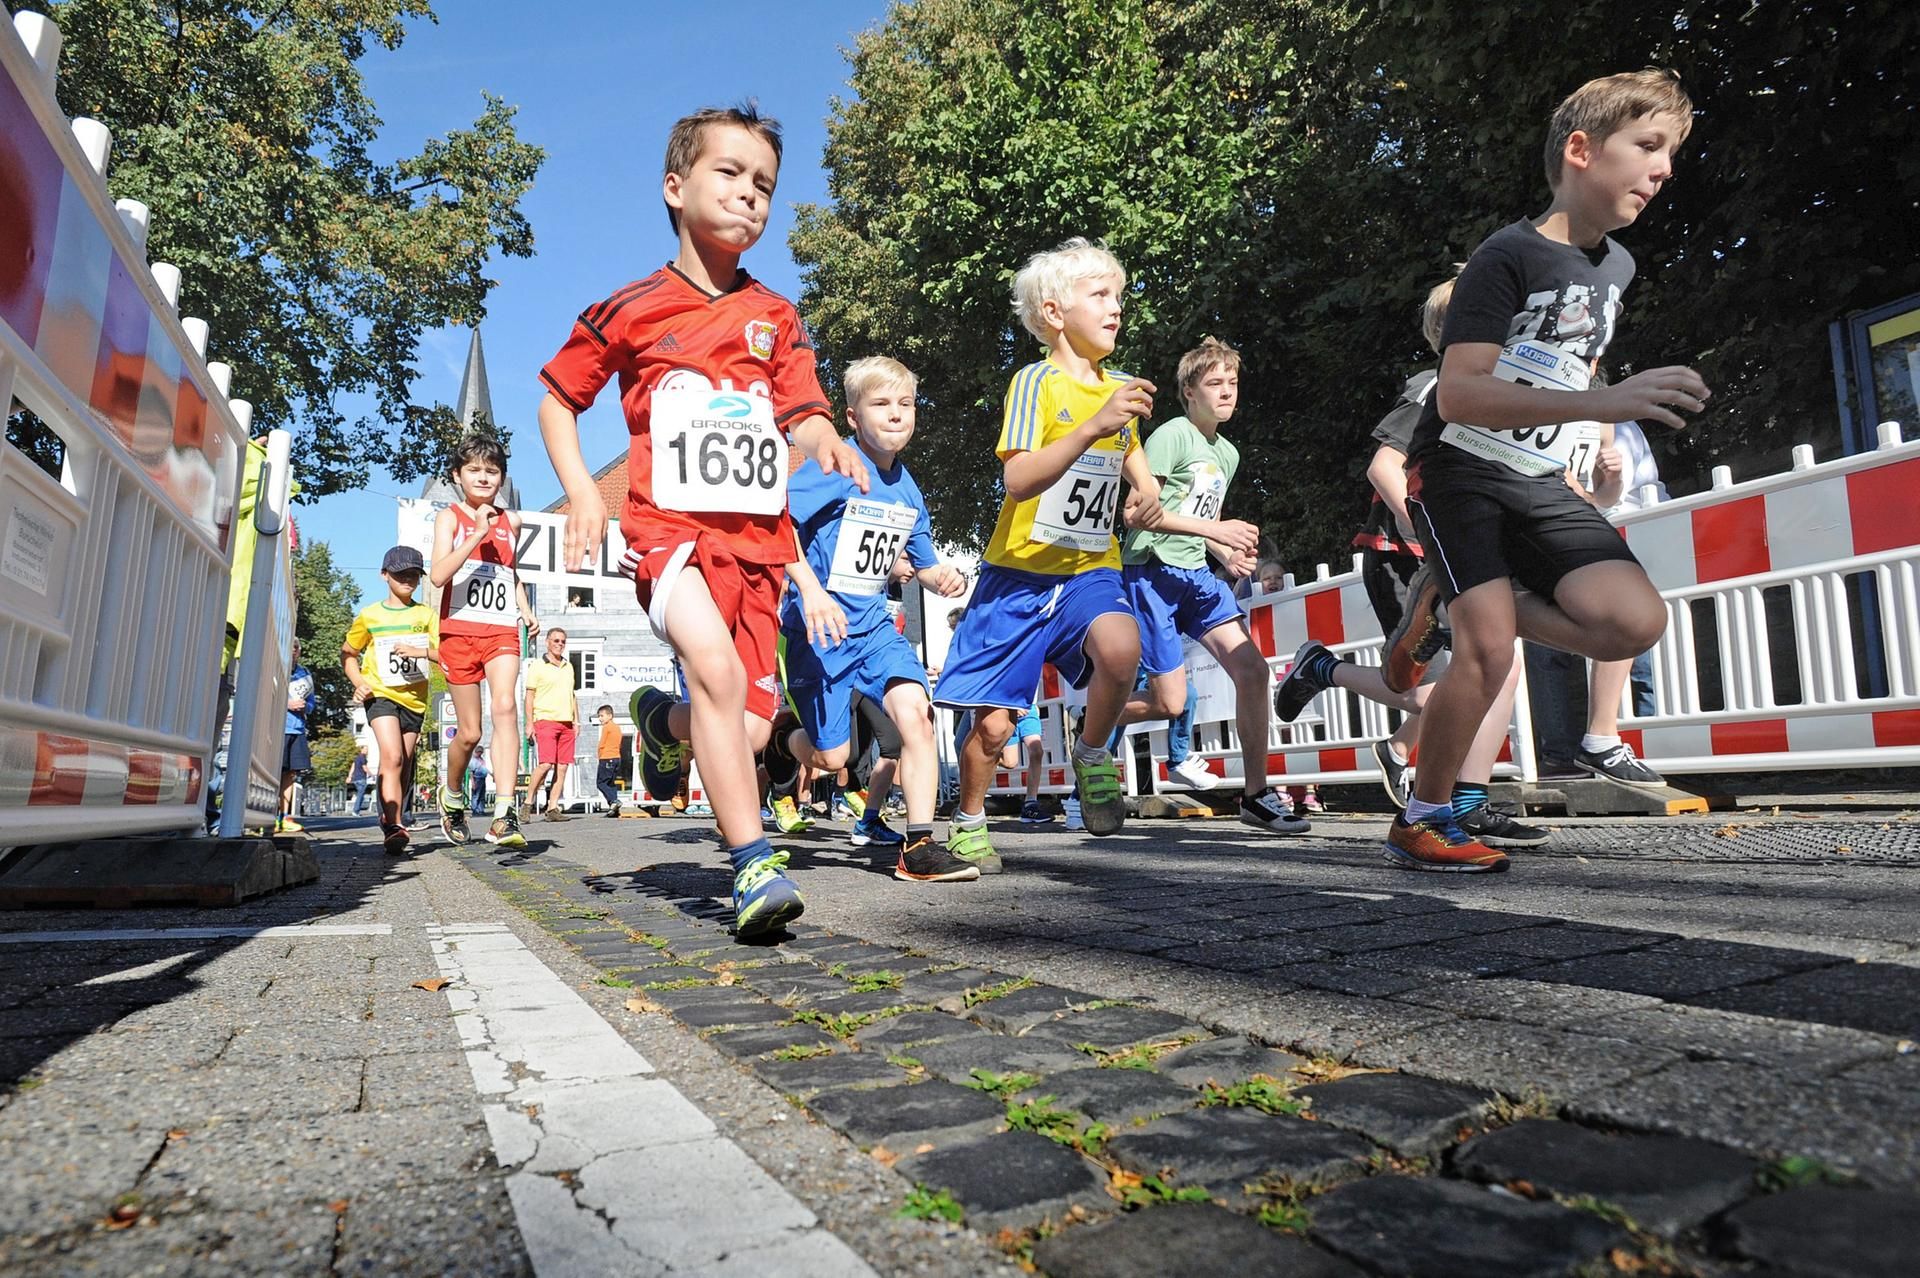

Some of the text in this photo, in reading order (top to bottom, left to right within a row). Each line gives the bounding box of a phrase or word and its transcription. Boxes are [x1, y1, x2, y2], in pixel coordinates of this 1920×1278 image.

[691, 419, 762, 433] BROOKS
[669, 431, 778, 489] 1638
[1079, 455, 1105, 467] OBRA
[1455, 431, 1513, 461] Burscheider
[1063, 478, 1118, 530] 549
[515, 522, 628, 579] ZIL
[855, 529, 901, 576] 565
[1042, 529, 1093, 546] Burscheider
[466, 578, 506, 611] 608
